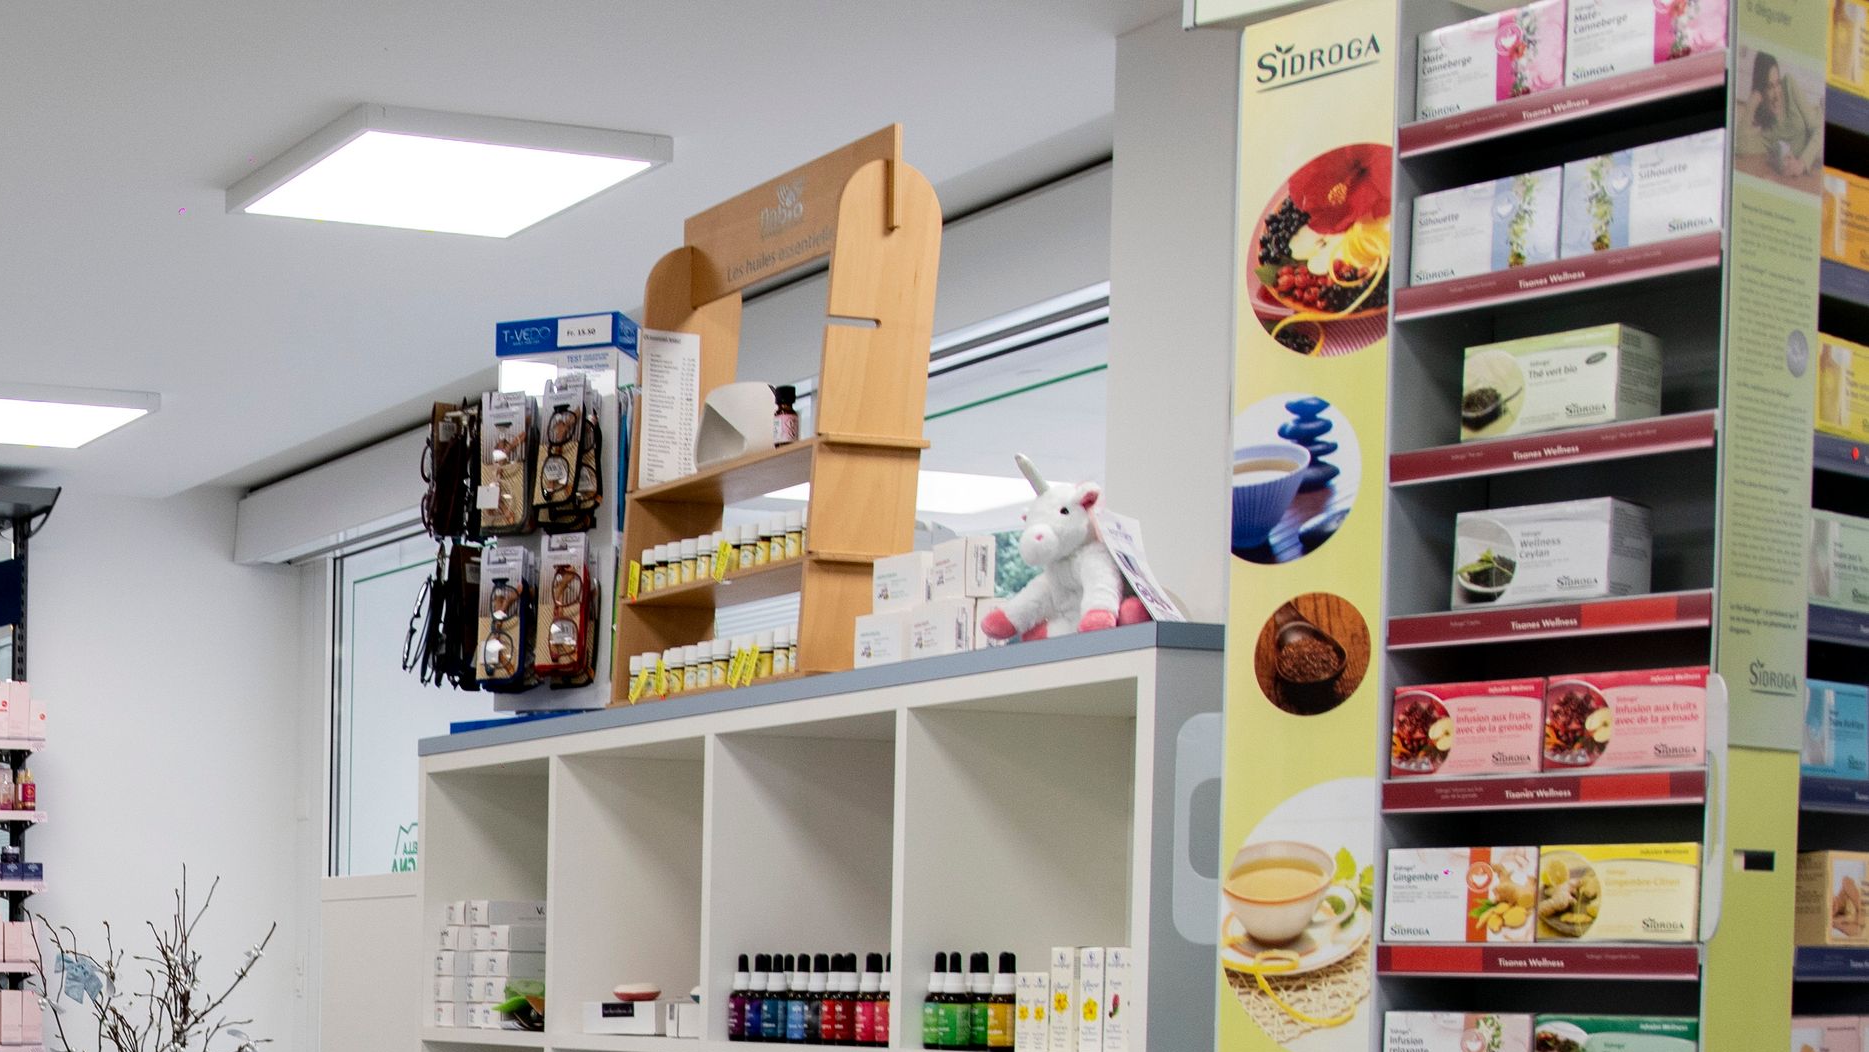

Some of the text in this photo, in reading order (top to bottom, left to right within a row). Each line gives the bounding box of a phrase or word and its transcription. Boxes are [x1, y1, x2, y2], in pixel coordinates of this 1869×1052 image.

[1256, 32, 1381, 84] SIDROGA
[1572, 64, 1615, 80] SIDROGA
[1521, 99, 1590, 122] Tisanes Wellness
[1668, 216, 1714, 233] SIDROGA
[1415, 269, 1455, 282] SIDROGA
[1518, 270, 1586, 290] Tisanes Wellness
[1546, 365, 1562, 378] vert
[1564, 364, 1577, 375] bio
[1565, 402, 1607, 416] SIDROGA
[1512, 443, 1579, 461] Tisanes Wellness
[1520, 536, 1561, 549] Wellness
[1519, 548, 1550, 561] Ceylan
[1556, 577, 1598, 589] SIDROGA
[1511, 616, 1578, 631] Tisanes Wellness
[1749, 659, 1797, 690] SIDROGA
[1615, 701, 1697, 715] Infusion aux fruits
[1456, 712, 1531, 724] Infusion aux fruits
[1614, 712, 1699, 724] avec de la grenade
[1456, 722, 1533, 734] avec de la grenade
[1654, 744, 1696, 756] SIDROGA
[1492, 753, 1531, 764] SIDROGA
[1505, 787, 1571, 799] Tisanes Wellness
[1393, 871, 1439, 883] Gingembre
[1390, 925, 1430, 936] SIDROGA
[1642, 918, 1684, 930] SIDROGA
[1498, 956, 1564, 968] Tisanes Wellness
[1390, 1035, 1424, 1046] Infusion
